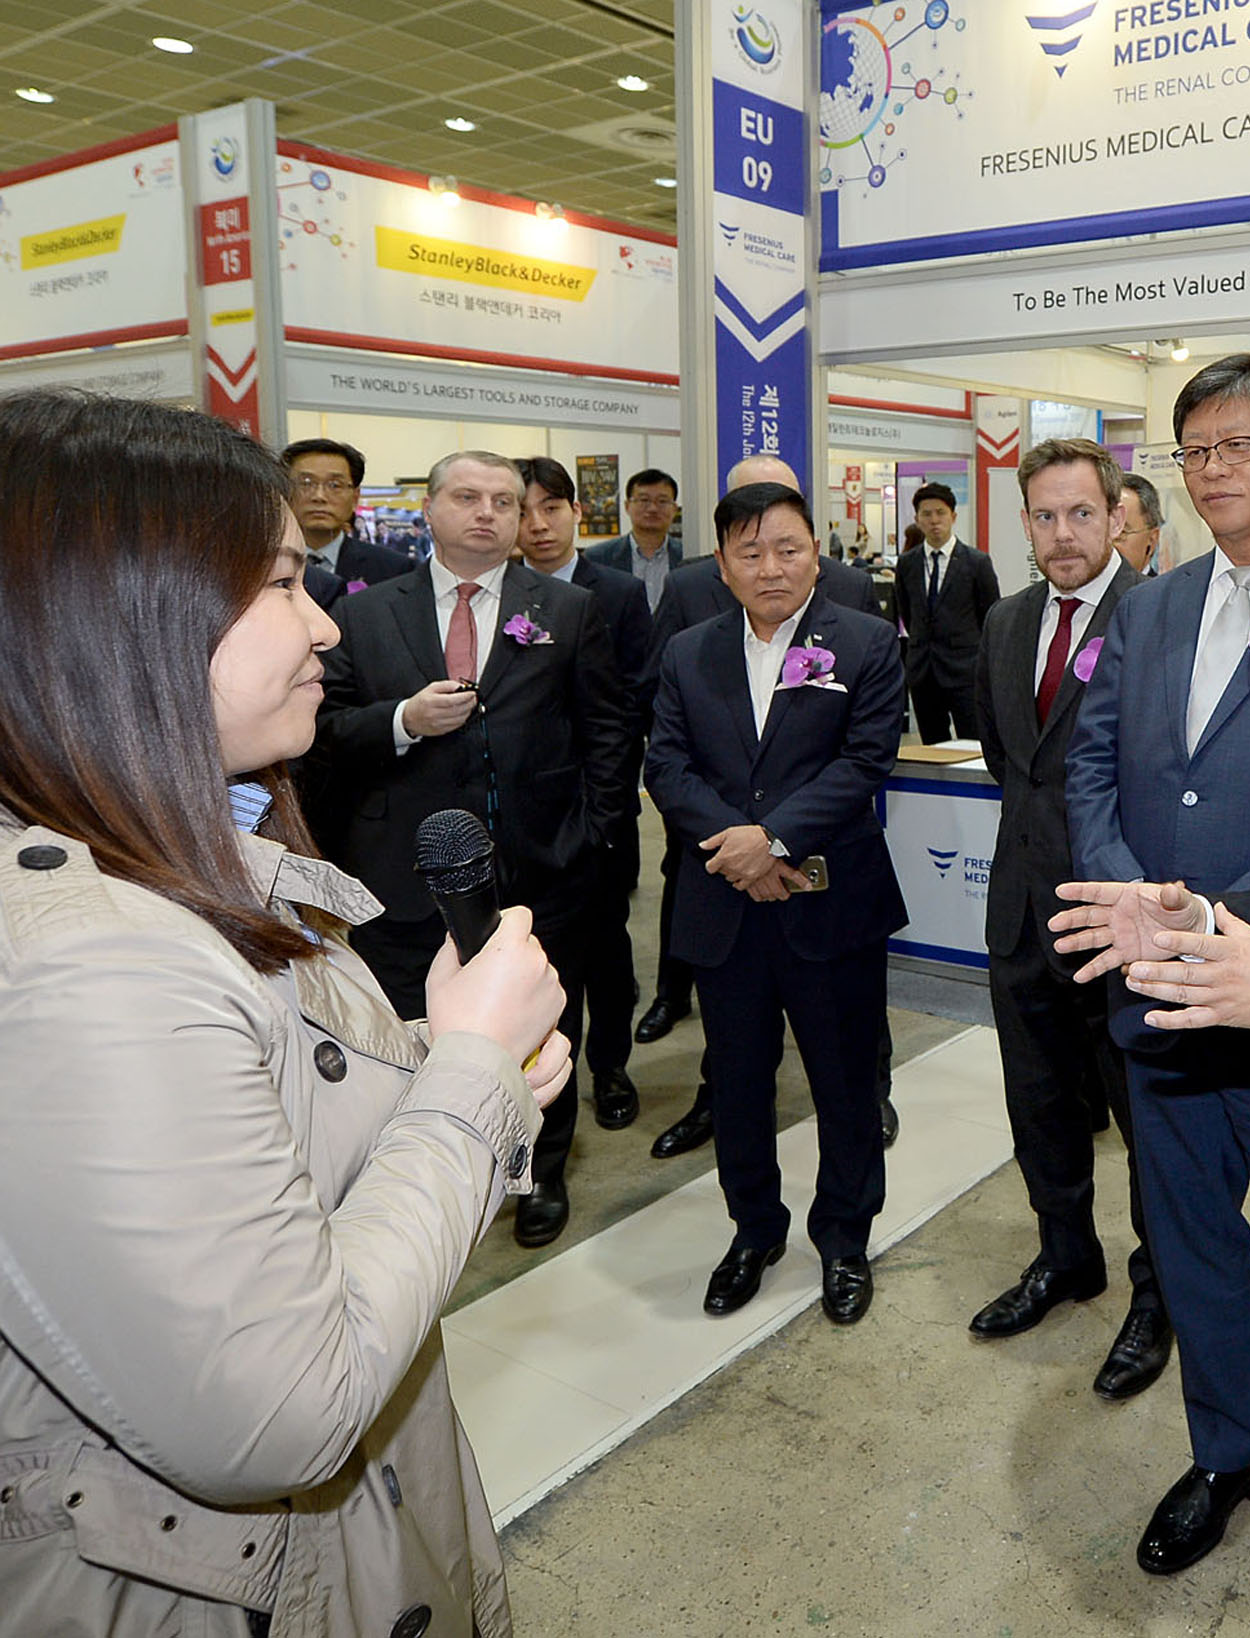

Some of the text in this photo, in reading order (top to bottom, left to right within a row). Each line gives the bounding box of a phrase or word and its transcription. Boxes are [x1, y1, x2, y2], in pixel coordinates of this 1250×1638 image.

[1114, 22, 1236, 67] MEDICAL
[1114, 83, 1148, 104] THE
[1154, 72, 1215, 99] RENAL
[740, 107, 774, 145] EU
[980, 139, 1098, 178] FRESENIUS
[1106, 122, 1214, 159] MEDICAL
[742, 156, 773, 192] 09
[220, 249, 241, 275] 15
[407, 243, 583, 291] StanleyBlack&Decker
[744, 244, 796, 264] MEDICAL CARE
[418, 290, 459, 308] 스탠리
[527, 305, 562, 324] 코리아
[1013, 292, 1037, 312] To
[1044, 290, 1066, 309] Be
[1073, 286, 1108, 307] The
[1115, 280, 1166, 302] Most
[1173, 271, 1246, 297] Valued
[331, 374, 356, 390] THE
[423, 384, 474, 399] LARGEST
[479, 389, 515, 404] TOOLS
[519, 393, 541, 406] AND
[544, 395, 590, 411] STORAGE
[592, 400, 639, 415] COMPANY
[742, 385, 755, 407] The
[742, 410, 755, 436] 12th
